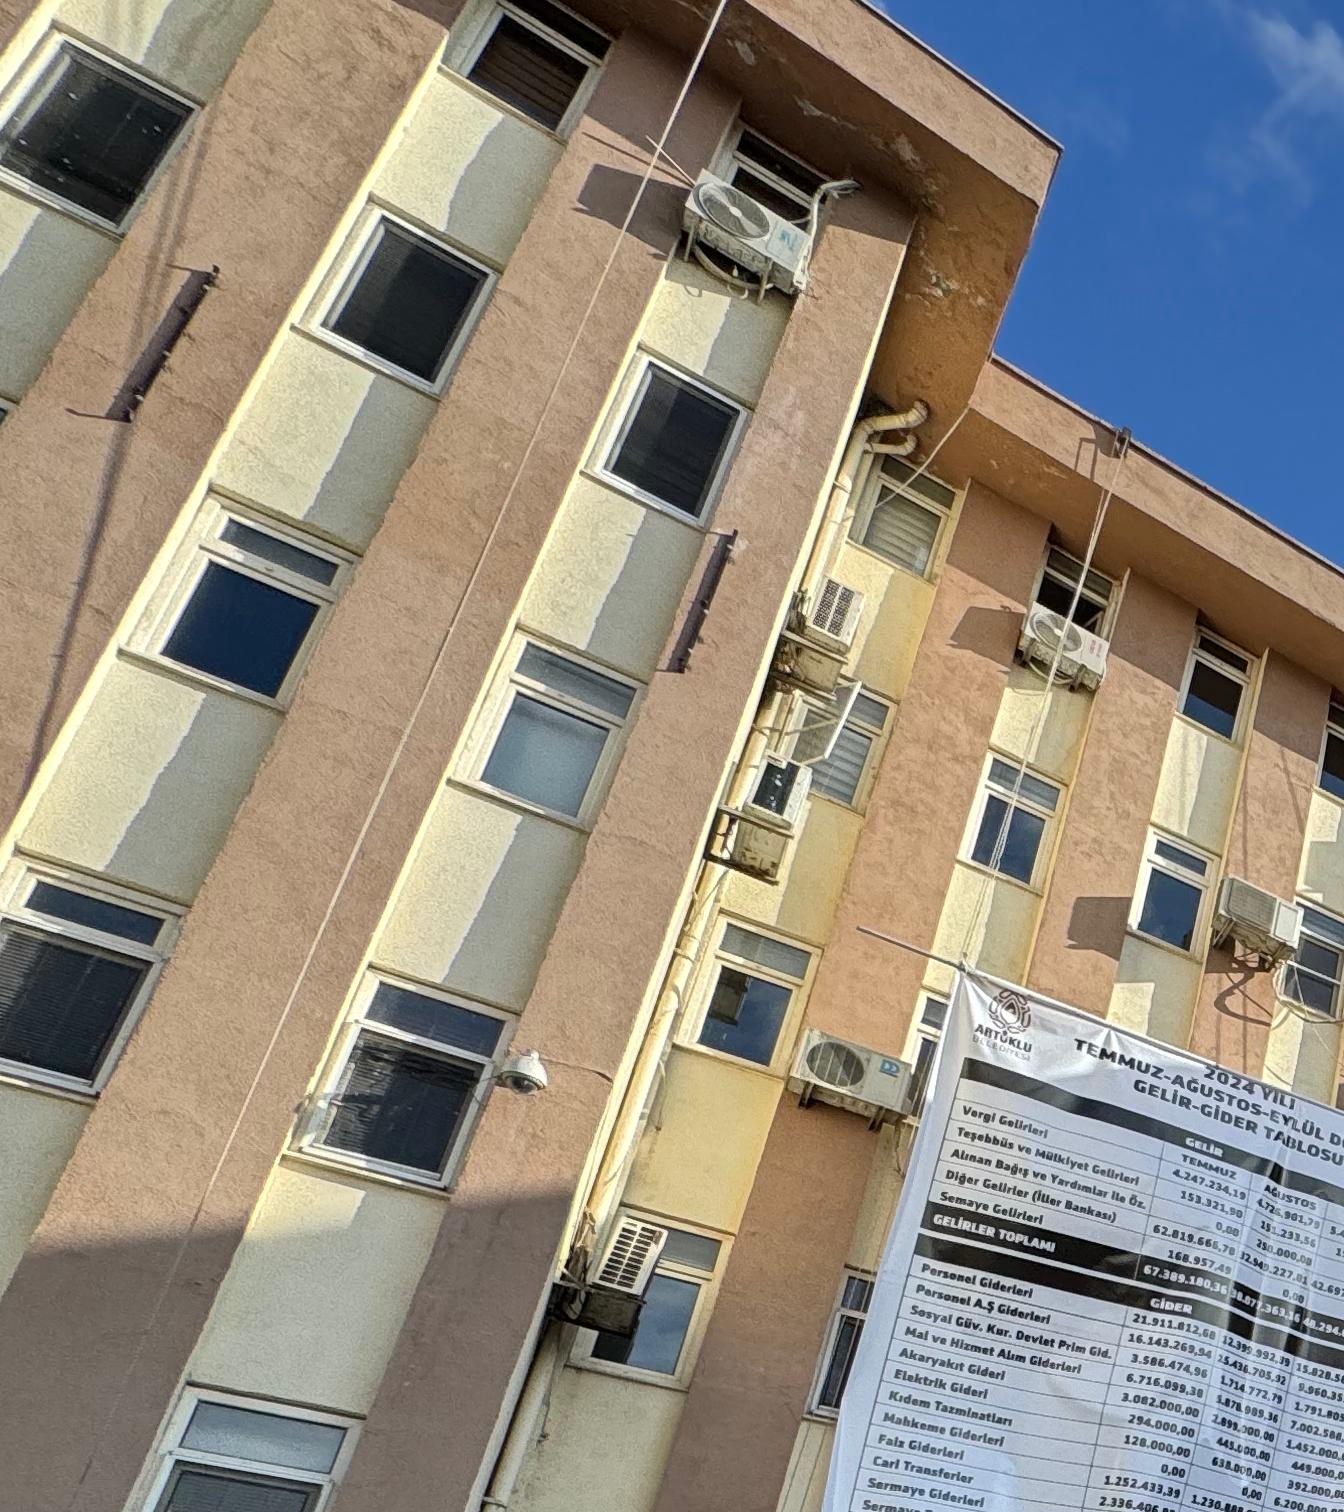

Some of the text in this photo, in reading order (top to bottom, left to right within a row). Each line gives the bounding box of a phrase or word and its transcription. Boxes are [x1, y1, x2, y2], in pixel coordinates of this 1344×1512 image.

[973, 1022, 1033, 1054] ARTUKLU
[1072, 1036, 1326, 1141] TEMMUZ-AĞUSTOS-EYLÜL
[1203, 1064, 1256, 1096] 2024
[1132, 1075, 1344, 1167] GELİR-GİDER TABLOSU
[1015, 1143, 1032, 1156] ve
[1184, 1133, 1224, 1158] GELİR
[1031, 1169, 1047, 1182] ve
[1180, 1153, 1237, 1180] TEMMUZ
[932, 1209, 996, 1241] GELİRLER
[997, 1226, 1056, 1256] TOPLAMI
[920, 1260, 977, 1286] Personel
[915, 1282, 971, 1307] Personel
[1149, 1294, 1193, 1316] GİDER
[908, 1303, 954, 1327] Sosyal
[903, 1325, 929, 1341] Mal
[930, 1333, 947, 1345] ve
[949, 1336, 995, 1357] Hizmet
[897, 1346, 965, 1374] Akaryakıt
[893, 1367, 948, 1390] Elektrik
[887, 1389, 932, 1410] Kıdem
[882, 1411, 947, 1435] Mahkeme
[877, 1433, 906, 1449] Faiz
[871, 1455, 900, 1471] Cari
[866, 1476, 926, 1499] Sermaye
